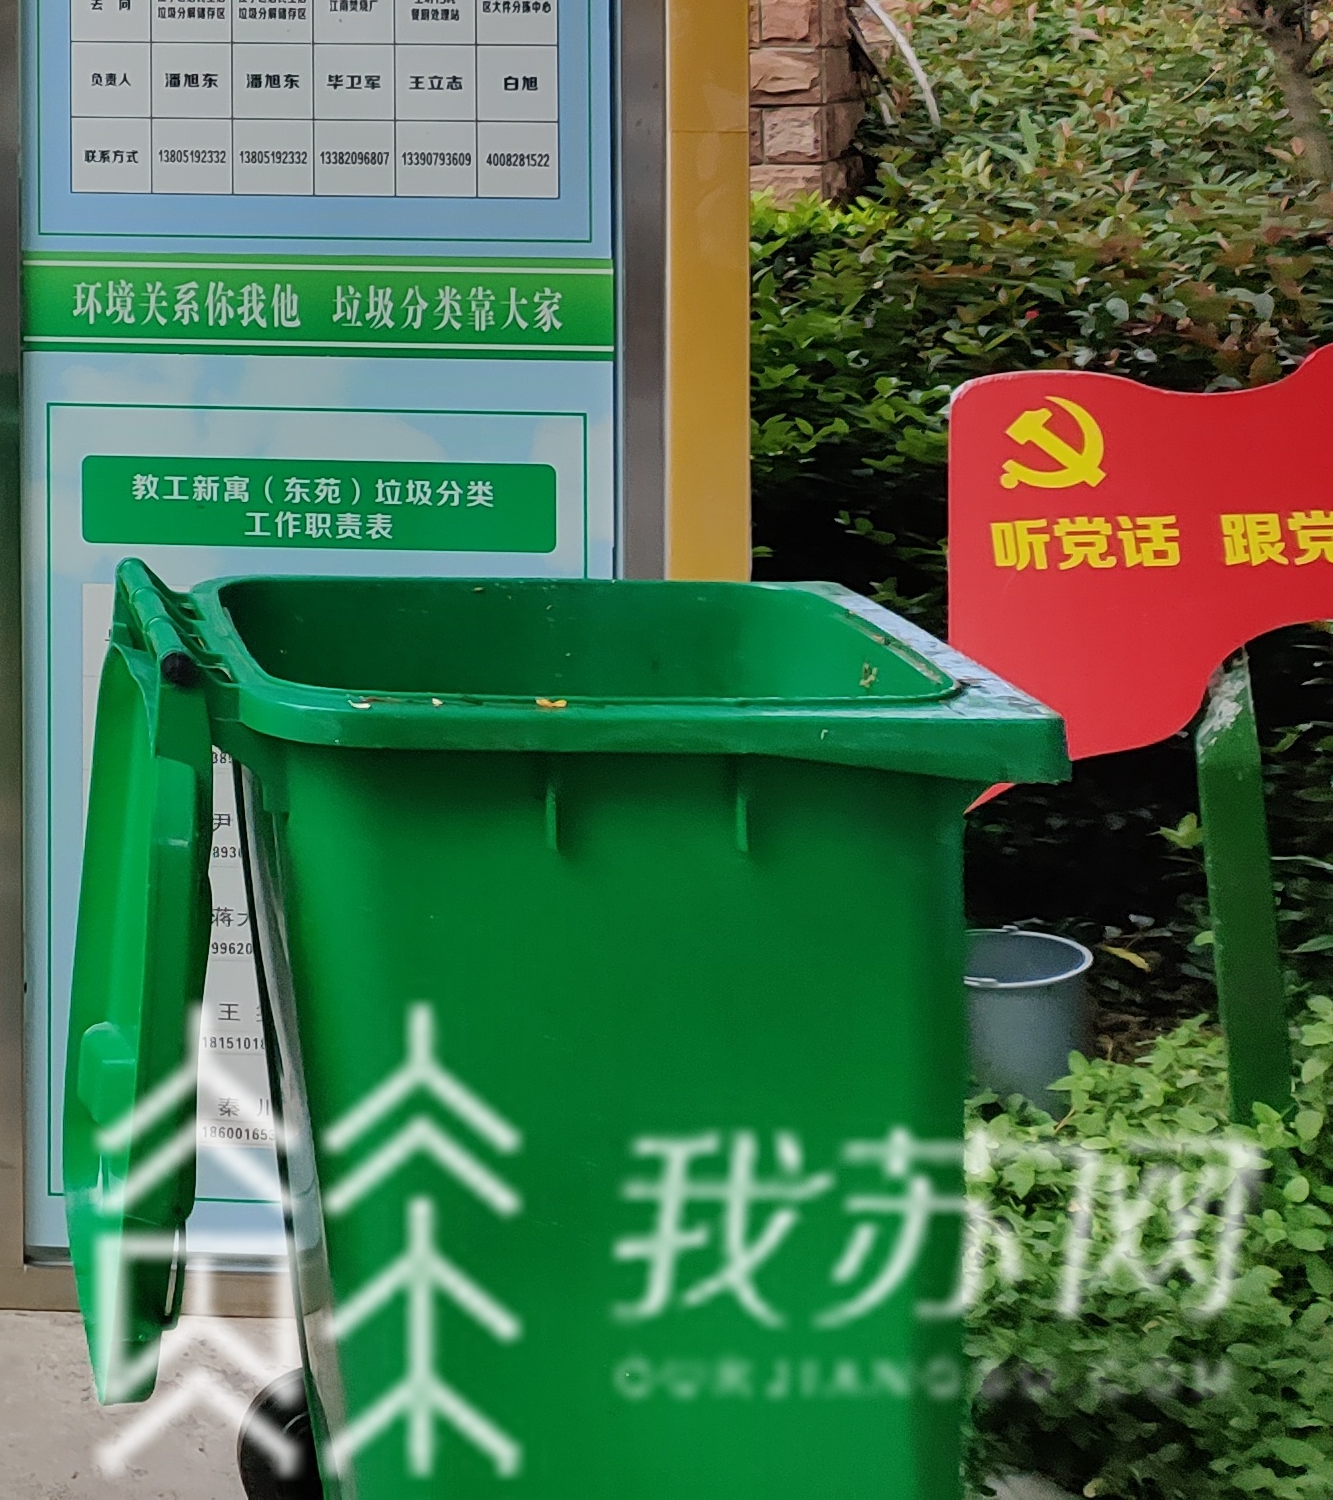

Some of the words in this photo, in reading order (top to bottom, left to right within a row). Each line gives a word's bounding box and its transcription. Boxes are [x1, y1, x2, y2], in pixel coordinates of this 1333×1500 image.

[91, 73, 131, 88] 负责人
[165, 73, 219, 88] 潘旭东
[246, 73, 300, 88] 潘旭东
[327, 74, 381, 89] 毕卫军
[409, 74, 463, 89] 王立志
[503, 74, 538, 89] 白旭
[84, 150, 139, 165] 联系方式
[158, 150, 226, 165] 13805192332
[239, 150, 307, 165] 13805192332
[320, 151, 390, 166] 13382096807
[401, 151, 472, 166] 13390793609
[486, 151, 550, 166] 4008281522
[72, 280, 301, 329] 环境关系你我他
[332, 284, 563, 333] 垃圾分类靠大家
[244, 511, 394, 541] 工作职责表
[990, 515, 1180, 571] 听党话
